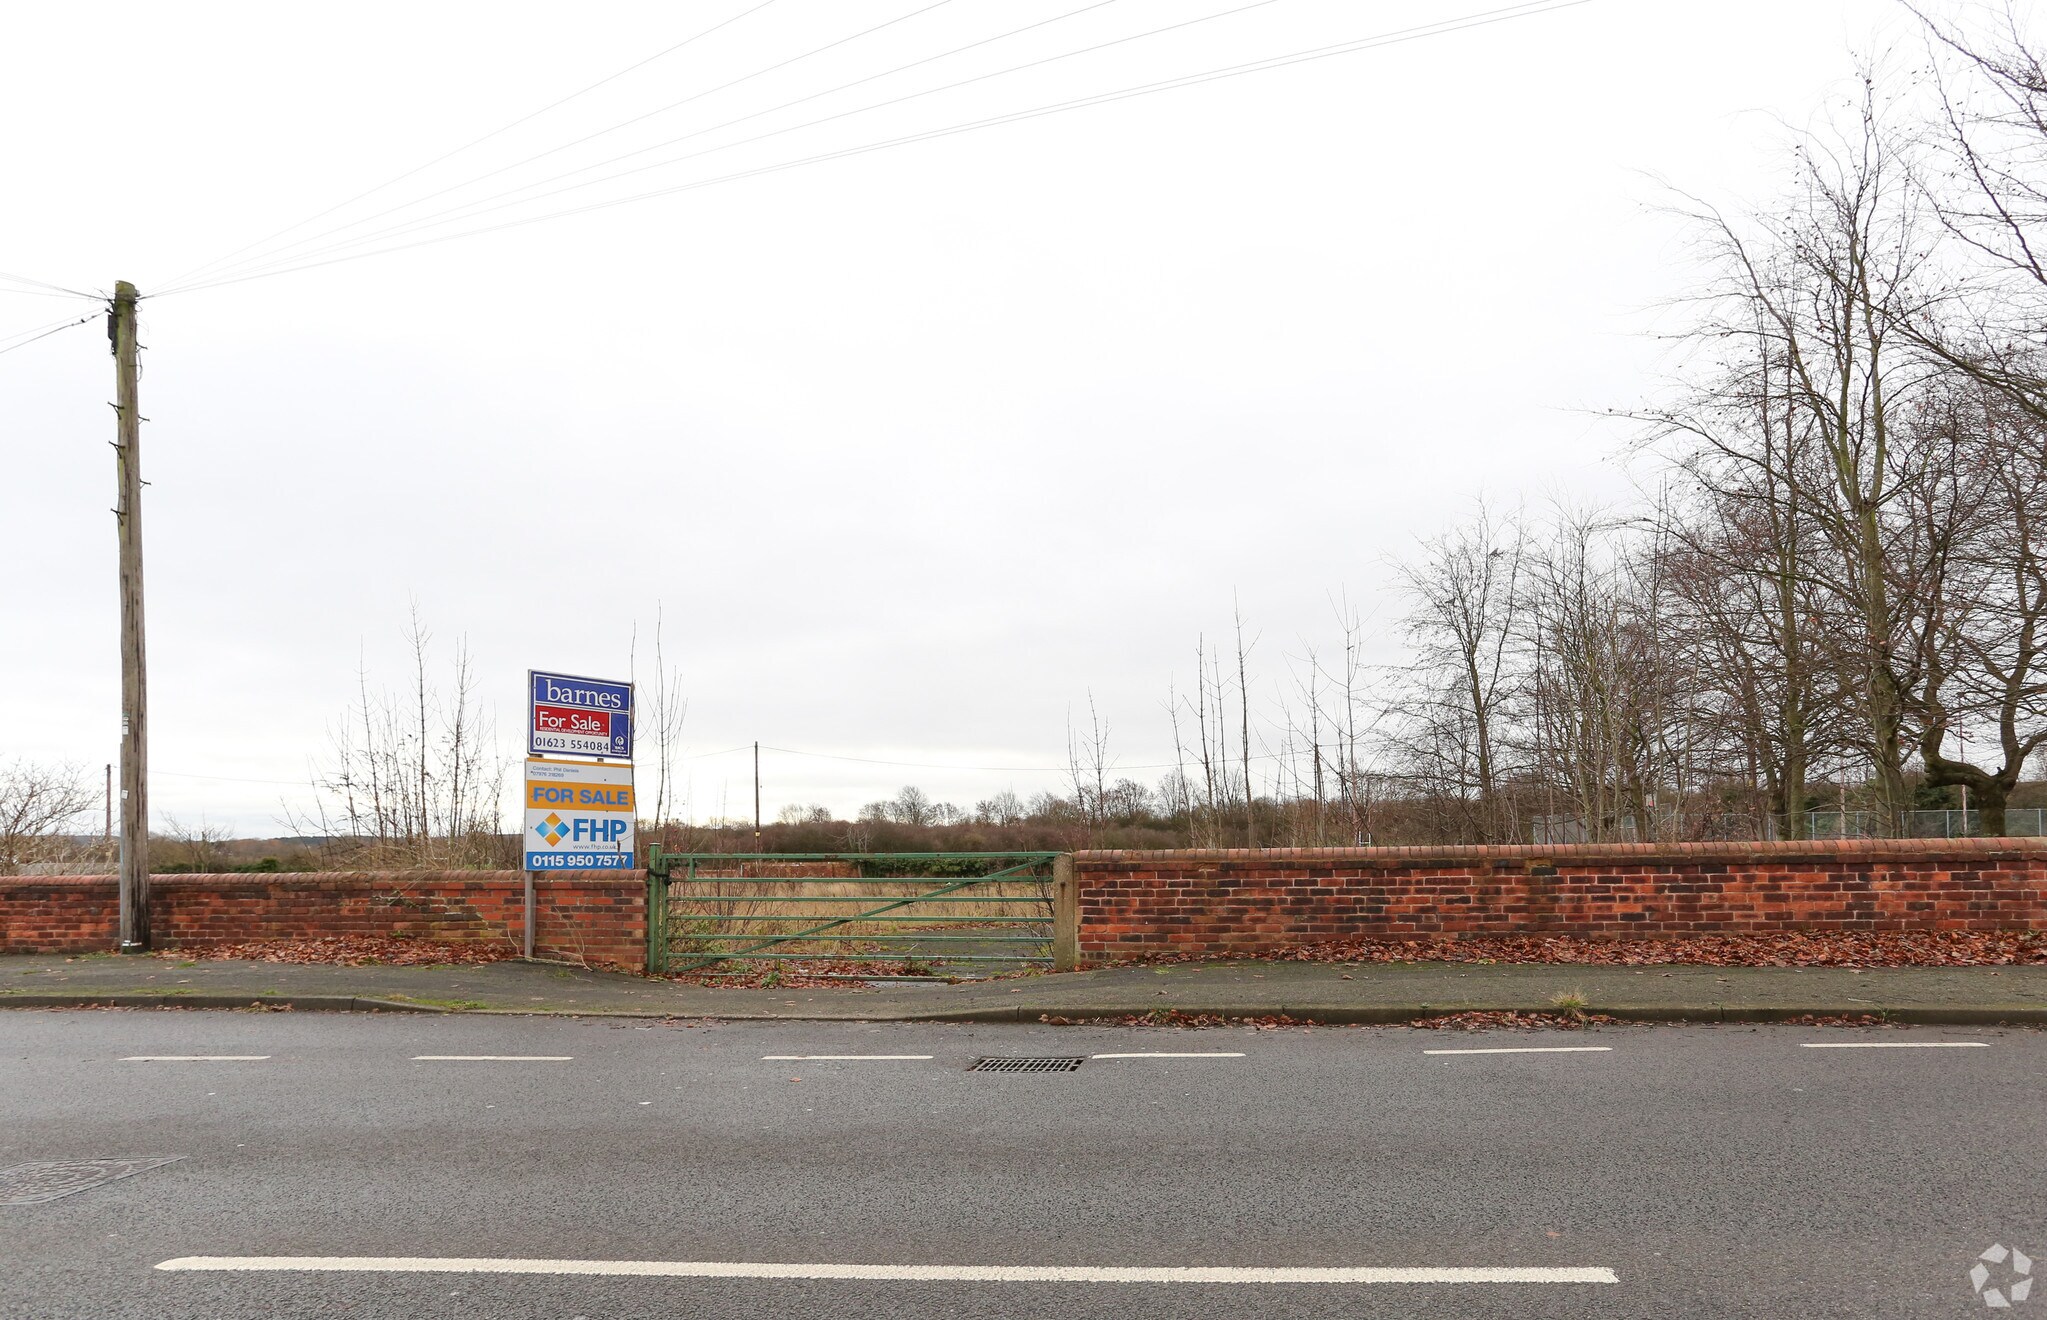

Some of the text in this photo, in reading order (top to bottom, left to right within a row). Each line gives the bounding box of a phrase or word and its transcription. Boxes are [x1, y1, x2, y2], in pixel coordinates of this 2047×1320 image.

[545, 679, 621, 708] barnes
[539, 711, 601, 731] For Sale
[535, 737, 609, 751] 01623 554084
[533, 787, 629, 805] FOR SALE
[573, 818, 627, 842] FHP
[532, 855, 628, 867] 0115 950 7577
